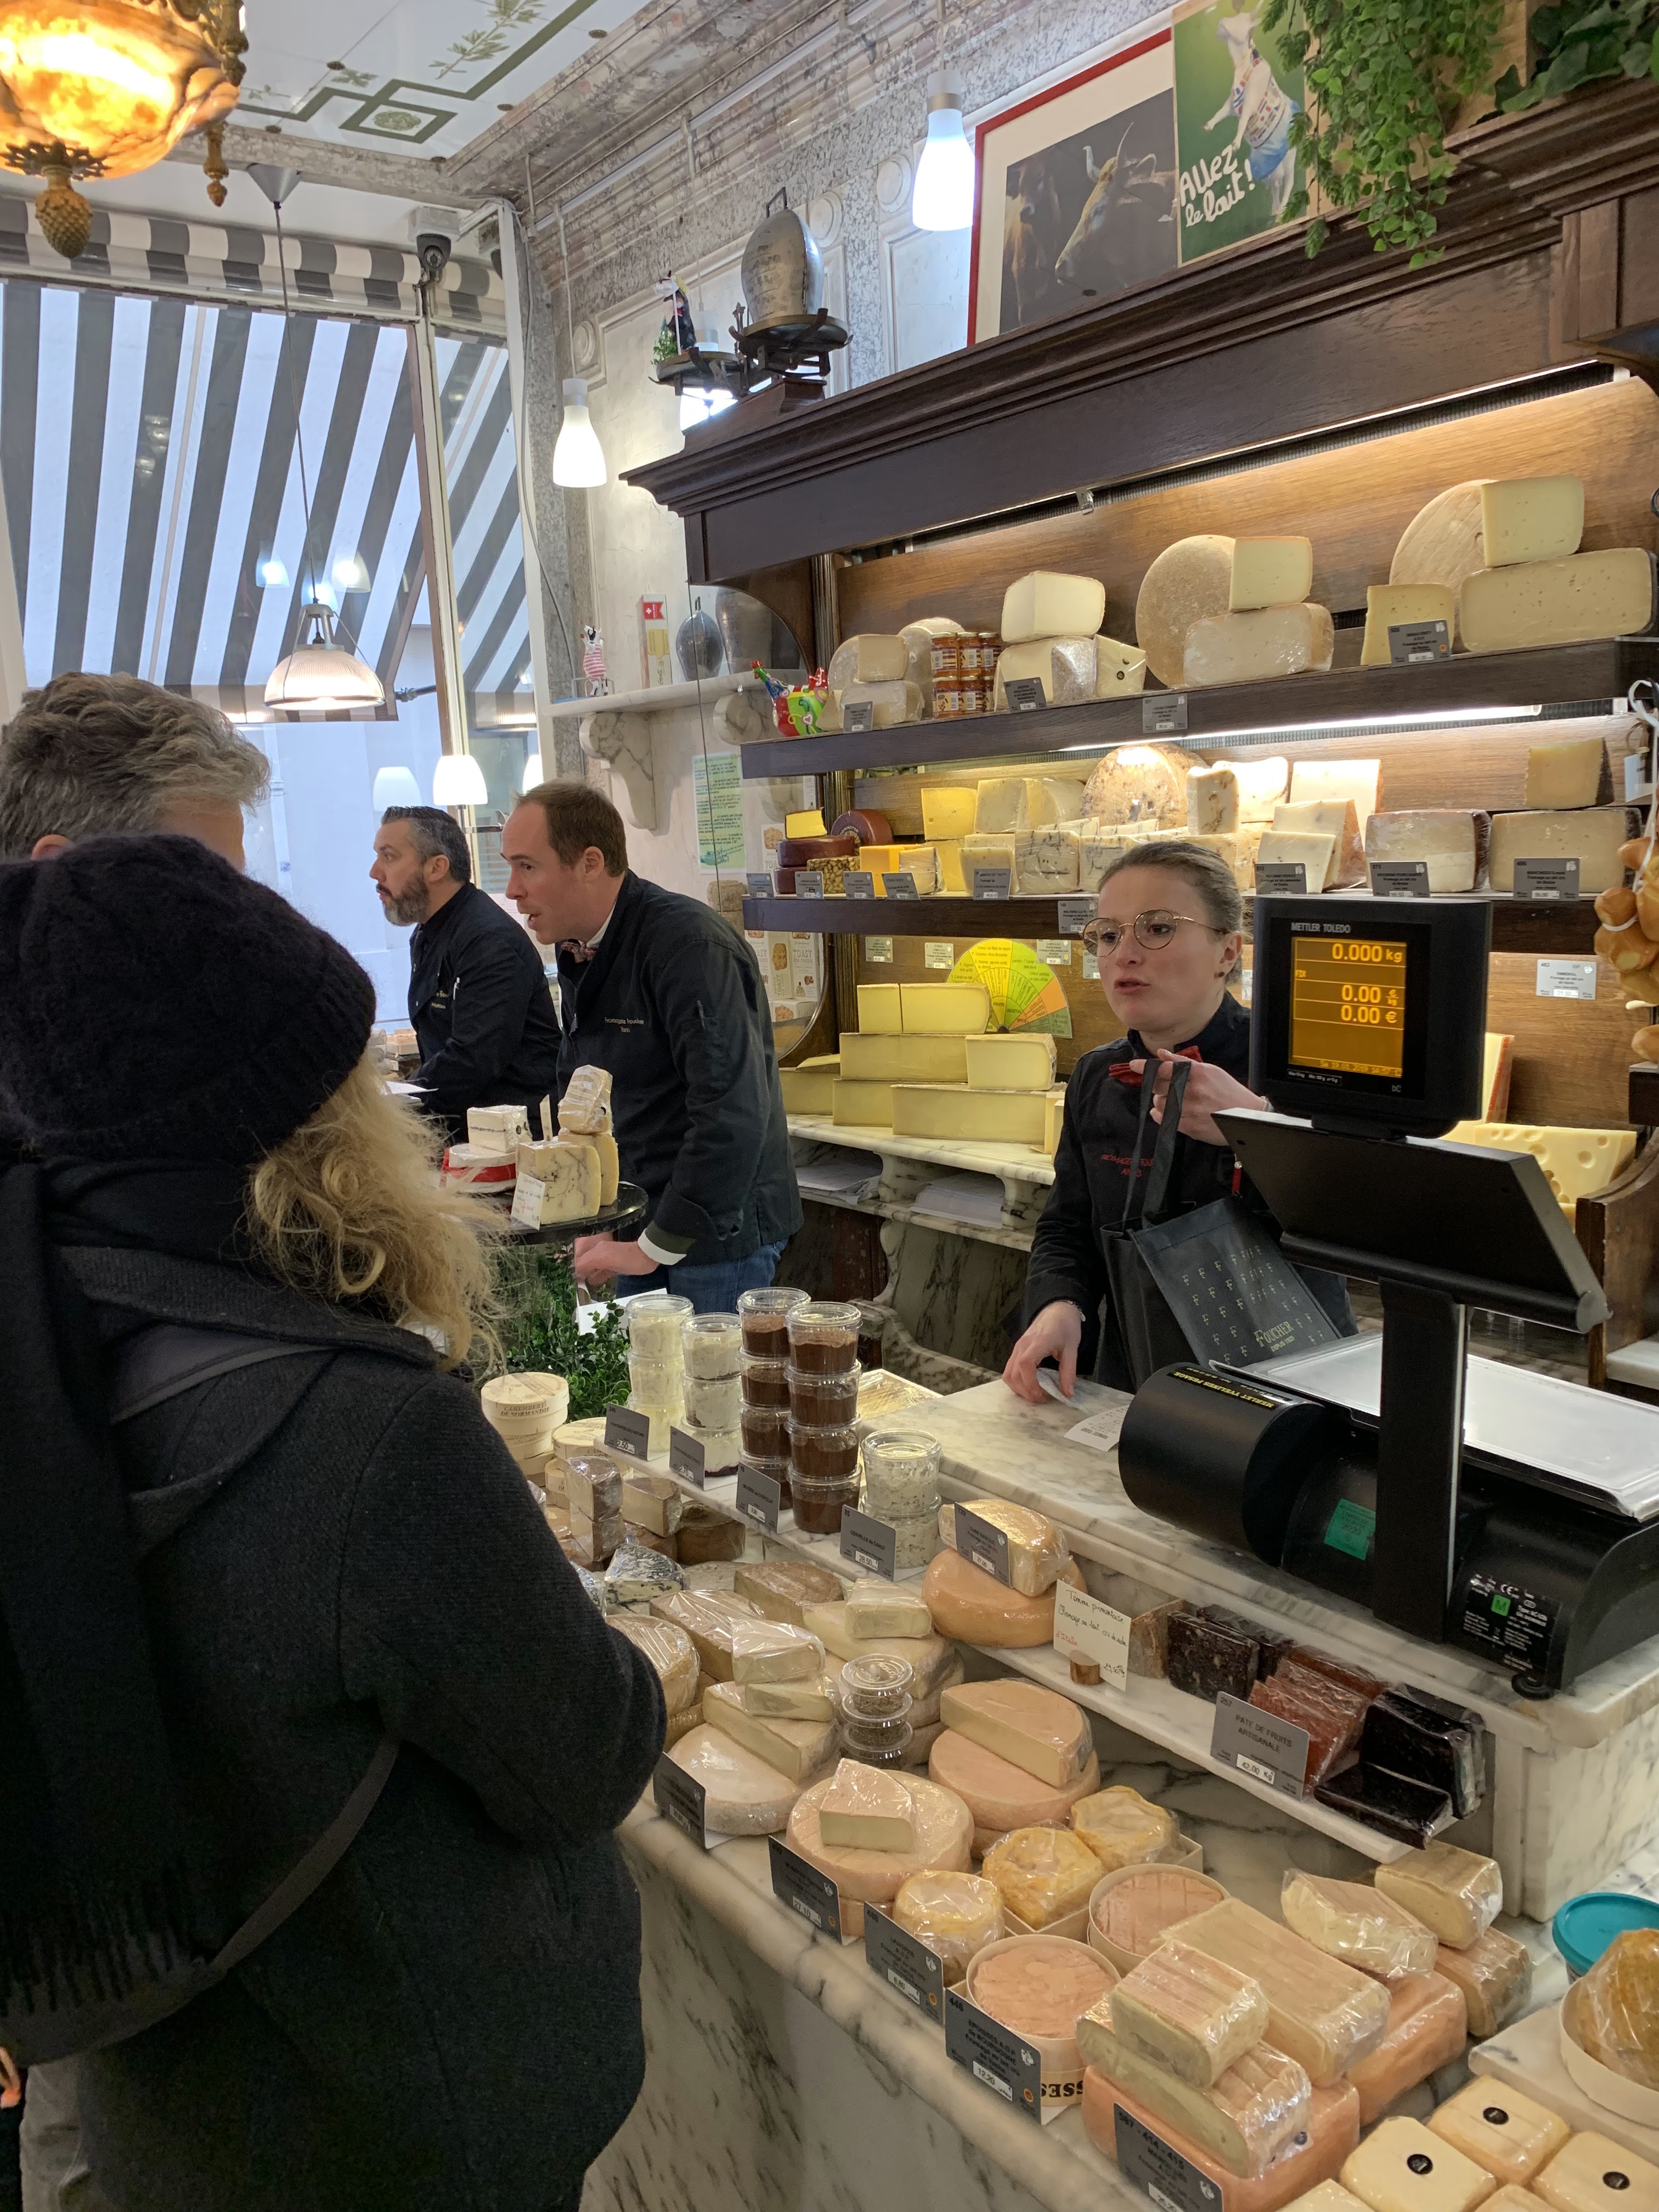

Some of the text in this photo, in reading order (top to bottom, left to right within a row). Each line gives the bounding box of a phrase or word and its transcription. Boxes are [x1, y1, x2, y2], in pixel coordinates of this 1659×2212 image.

[1180, 145, 1238, 207] Allez
[1186, 203, 1204, 227] le
[765, 861, 778, 869] TOA
[1291, 922, 1351, 933] METTLER TOLEDO
[793, 949, 812, 958] TOAST
[1331, 943, 1403, 963] 0.000 kg
[1341, 985, 1381, 1003] 0.00
[1341, 1005, 1397, 1024] 0.00 €
[1254, 1321, 1294, 1347] FOUCHER
[504, 1402, 544, 1411] CAMEMBERT
[511, 1407, 550, 1417] NORMANDIE
[617, 1440, 628, 1451] 2.50
[850, 1530, 868, 1543] CERVELLE
[859, 1554, 872, 1567] 28.50
[1065, 1590, 1090, 1607] Tomme
[1221, 1696, 1232, 1707] 257
[1238, 1728, 1281, 1753] ARTISANALE
[1255, 1723, 1265, 1733] DE
[1266, 1729, 1292, 1747] FRUITS
[1242, 1762, 1260, 1776] 42.00
[966, 2033, 990, 2057] Fromage
[991, 2052, 999, 2063] au
[1000, 2057, 1009, 2070] lait
[968, 2027, 1016, 2066] de BOURGOGNE
[988, 2056, 1005, 2074] Vache
[1142, 2129, 1159, 2151] 414
